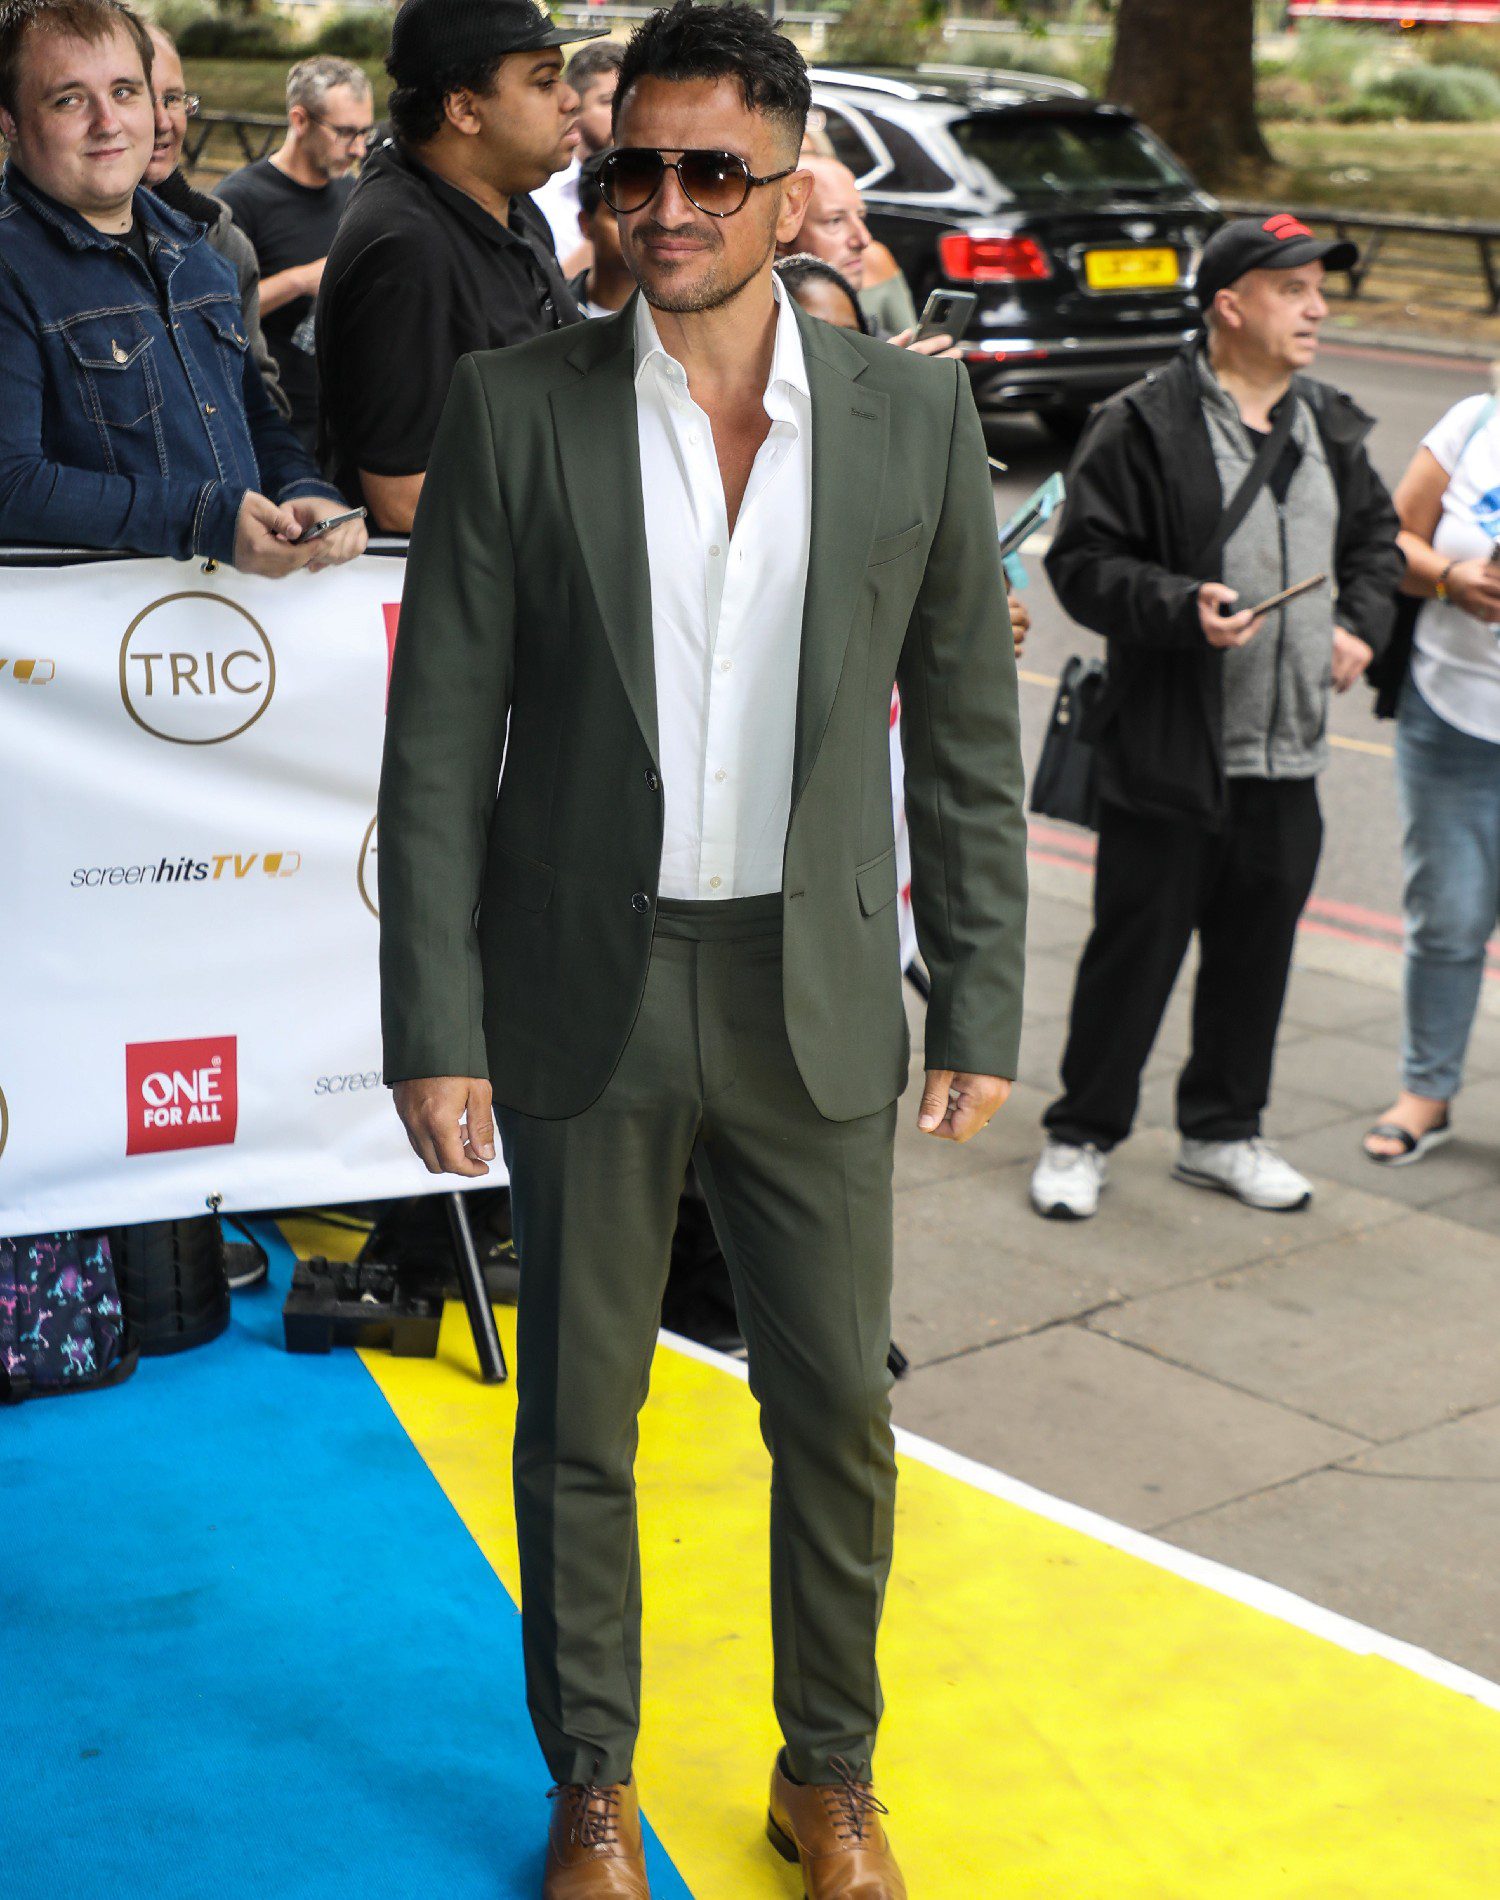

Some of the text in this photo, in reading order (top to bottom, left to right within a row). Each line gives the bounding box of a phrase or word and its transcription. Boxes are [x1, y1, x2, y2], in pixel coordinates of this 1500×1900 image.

[130, 650, 262, 696] TRIC
[70, 853, 258, 888] screenhitsTV
[141, 1067, 222, 1107] ONE
[143, 1102, 222, 1129] FOR ALL
